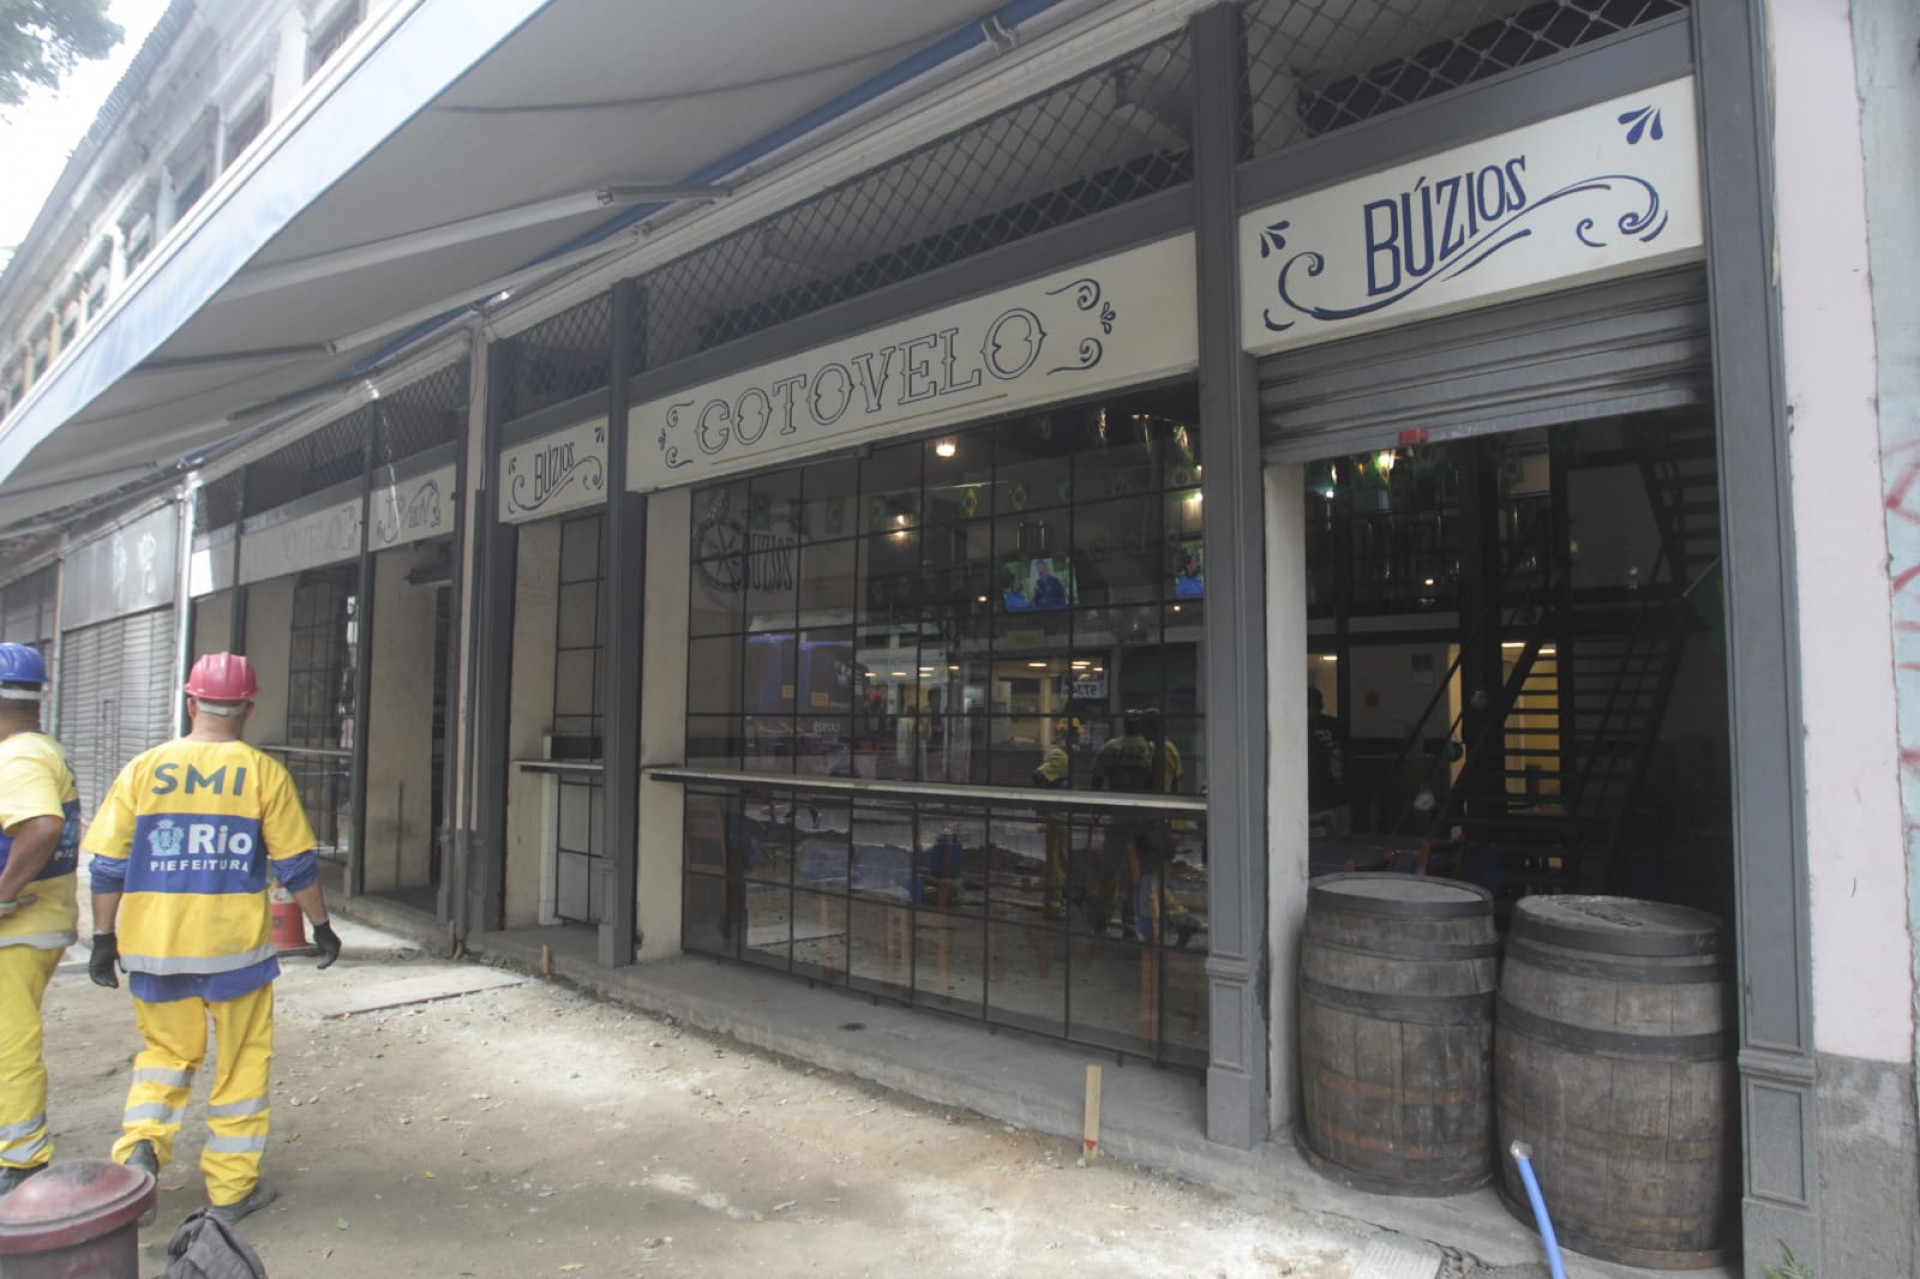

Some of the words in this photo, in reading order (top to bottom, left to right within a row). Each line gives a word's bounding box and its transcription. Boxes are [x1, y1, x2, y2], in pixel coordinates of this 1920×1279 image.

[1363, 155, 1527, 296] BÚZIOS
[697, 308, 1048, 455] COTOVELO
[151, 763, 247, 797] SMI
[188, 823, 253, 855] Rio
